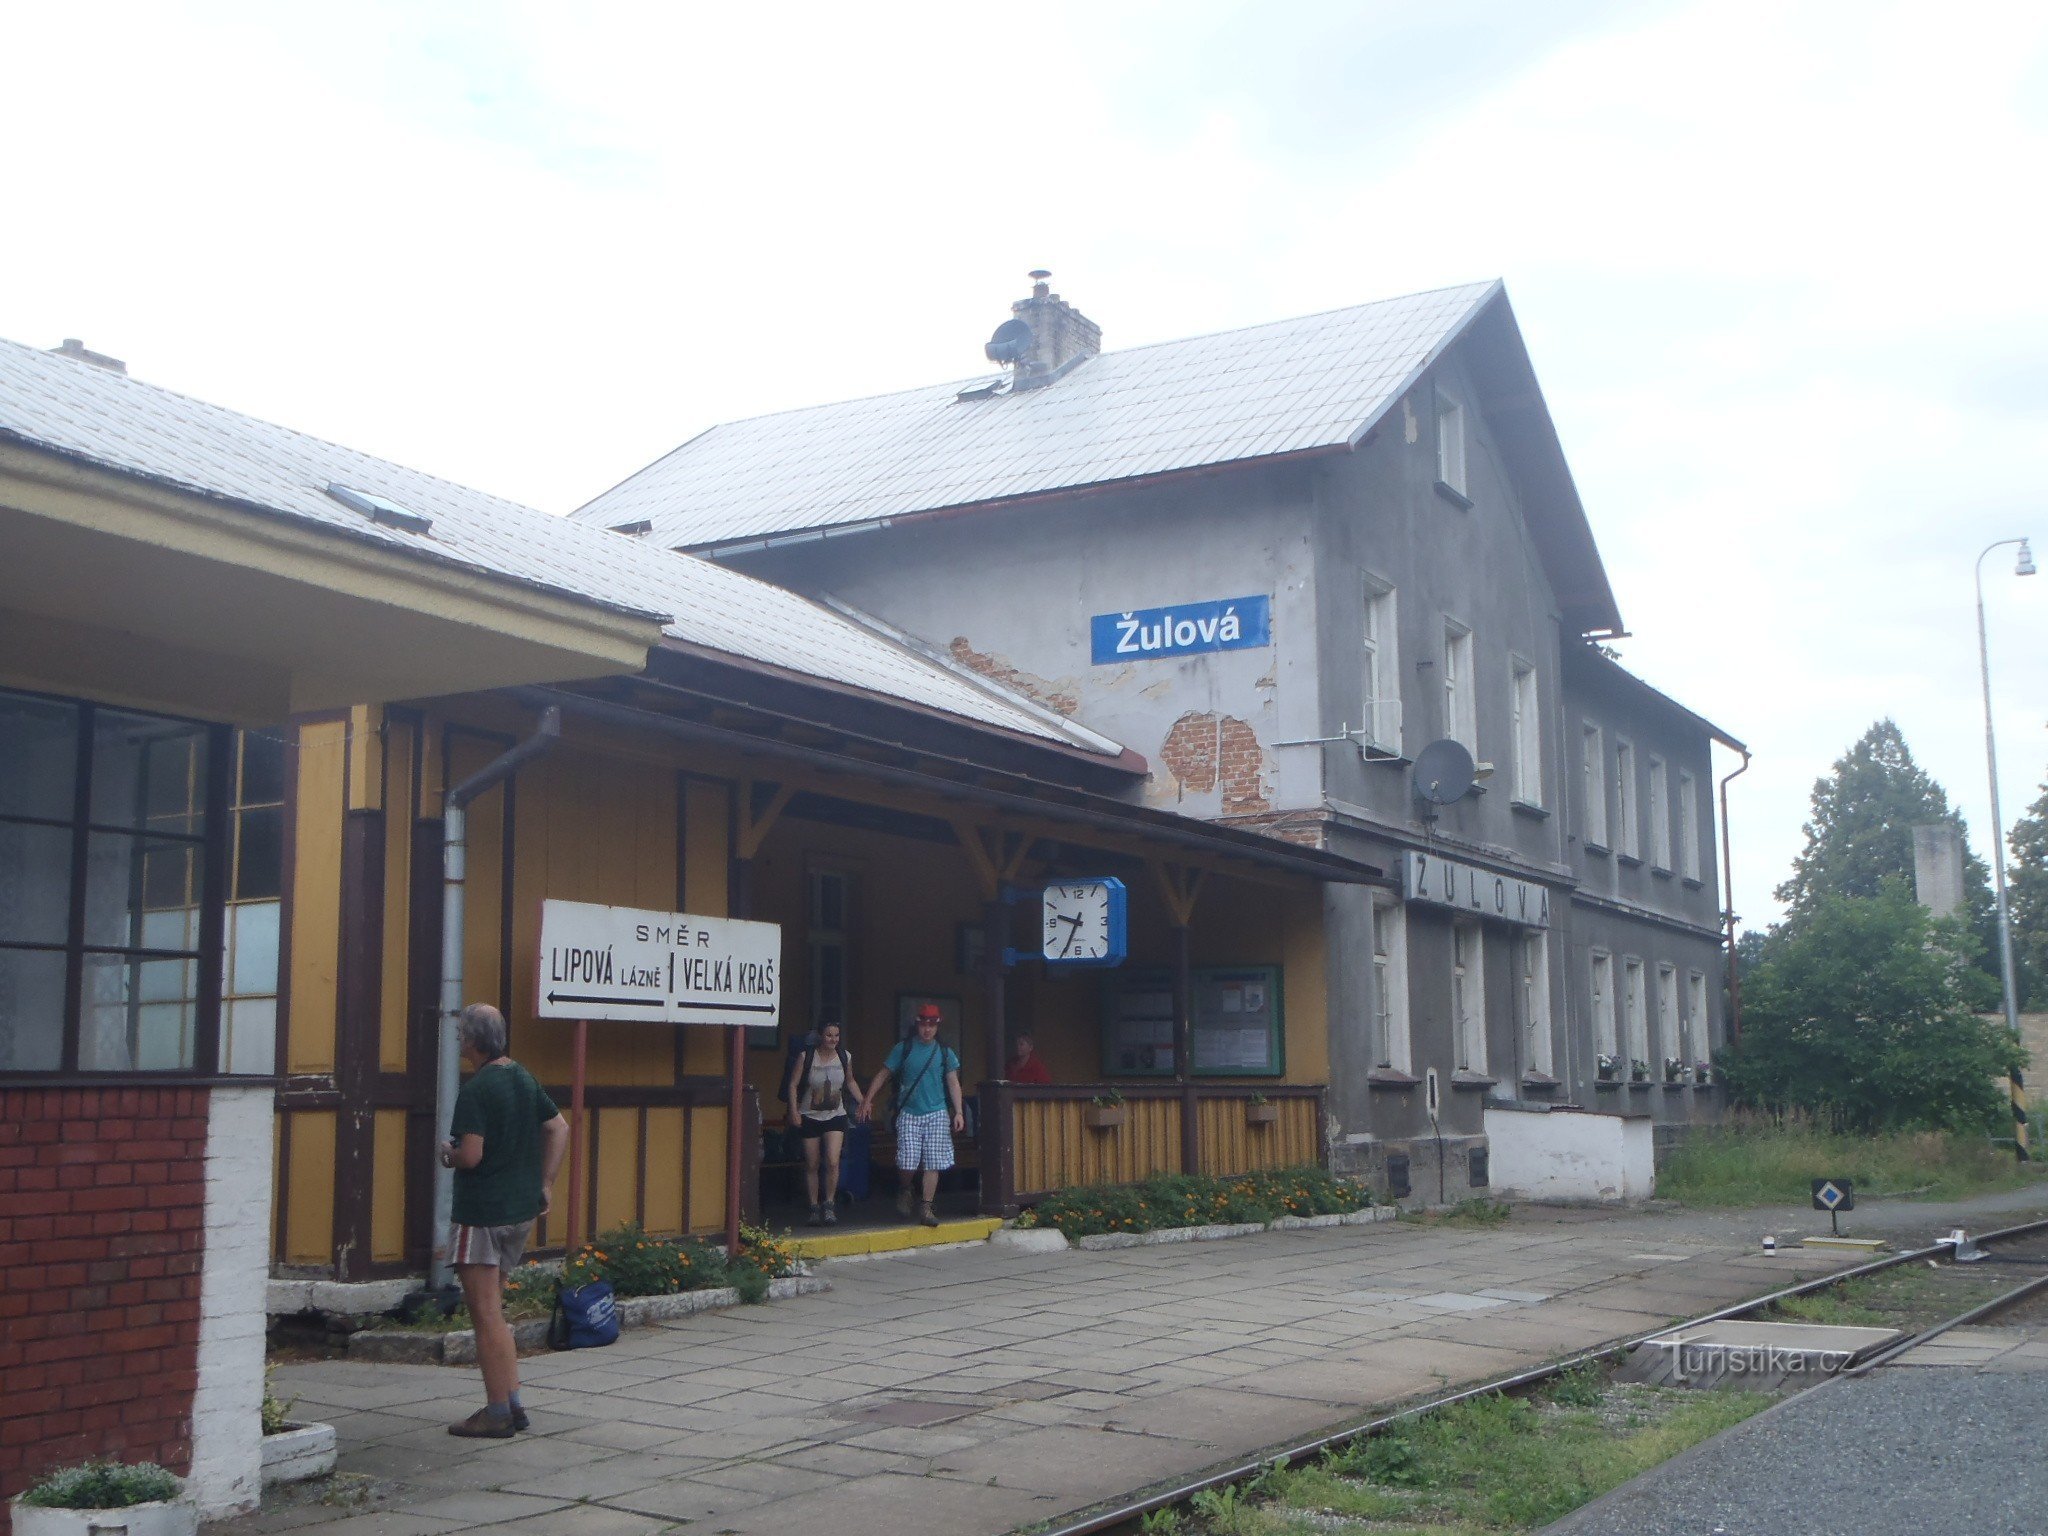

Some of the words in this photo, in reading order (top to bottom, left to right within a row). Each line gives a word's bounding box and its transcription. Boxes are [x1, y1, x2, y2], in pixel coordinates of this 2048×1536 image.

[1116, 606, 1240, 653] Žulová
[1073, 889, 1084, 899] 12
[636, 924, 710, 948] SMĚR
[551, 944, 613, 985] LIPOVÁ
[620, 965, 661, 988] LÁZNĚ
[683, 955, 732, 993] VELKÁ
[738, 958, 774, 995] KRAŠ
